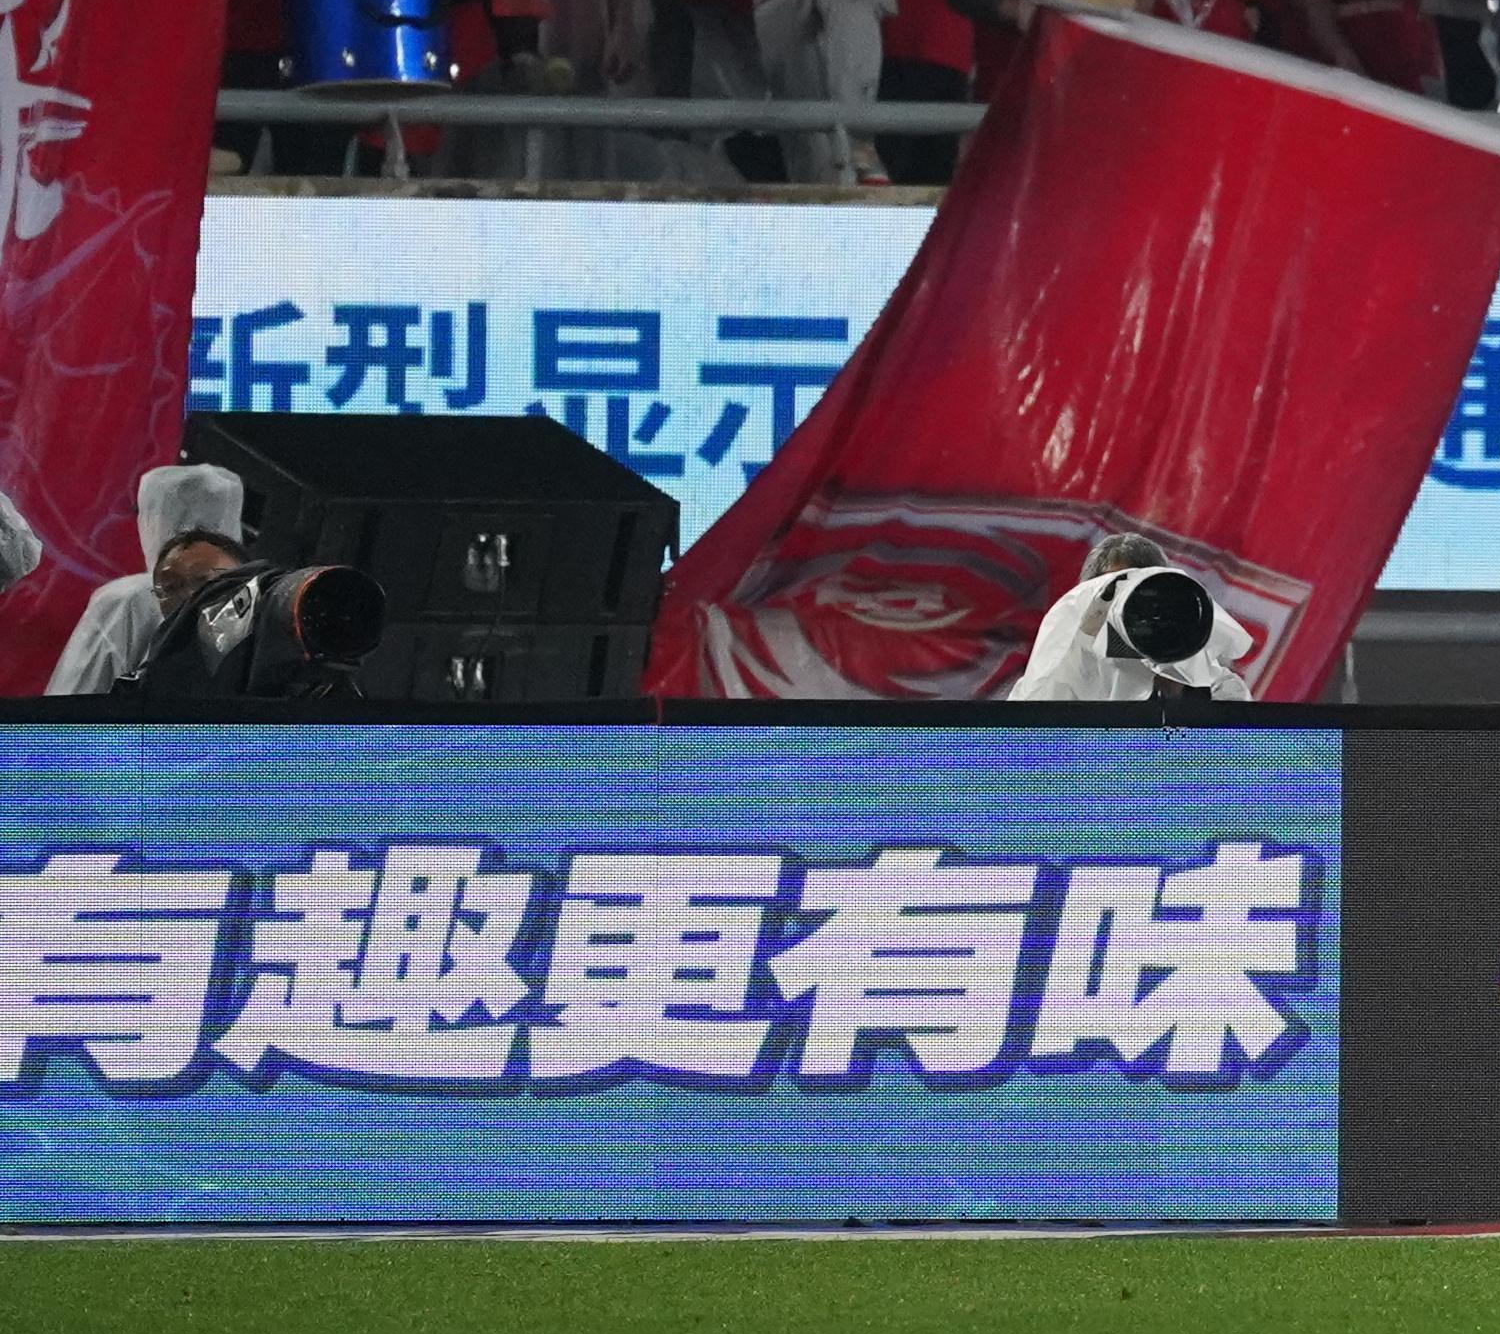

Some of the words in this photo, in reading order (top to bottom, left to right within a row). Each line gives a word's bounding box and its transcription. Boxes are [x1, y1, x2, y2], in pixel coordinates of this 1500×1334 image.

[0, 840, 1312, 1085] 有趣更有味
